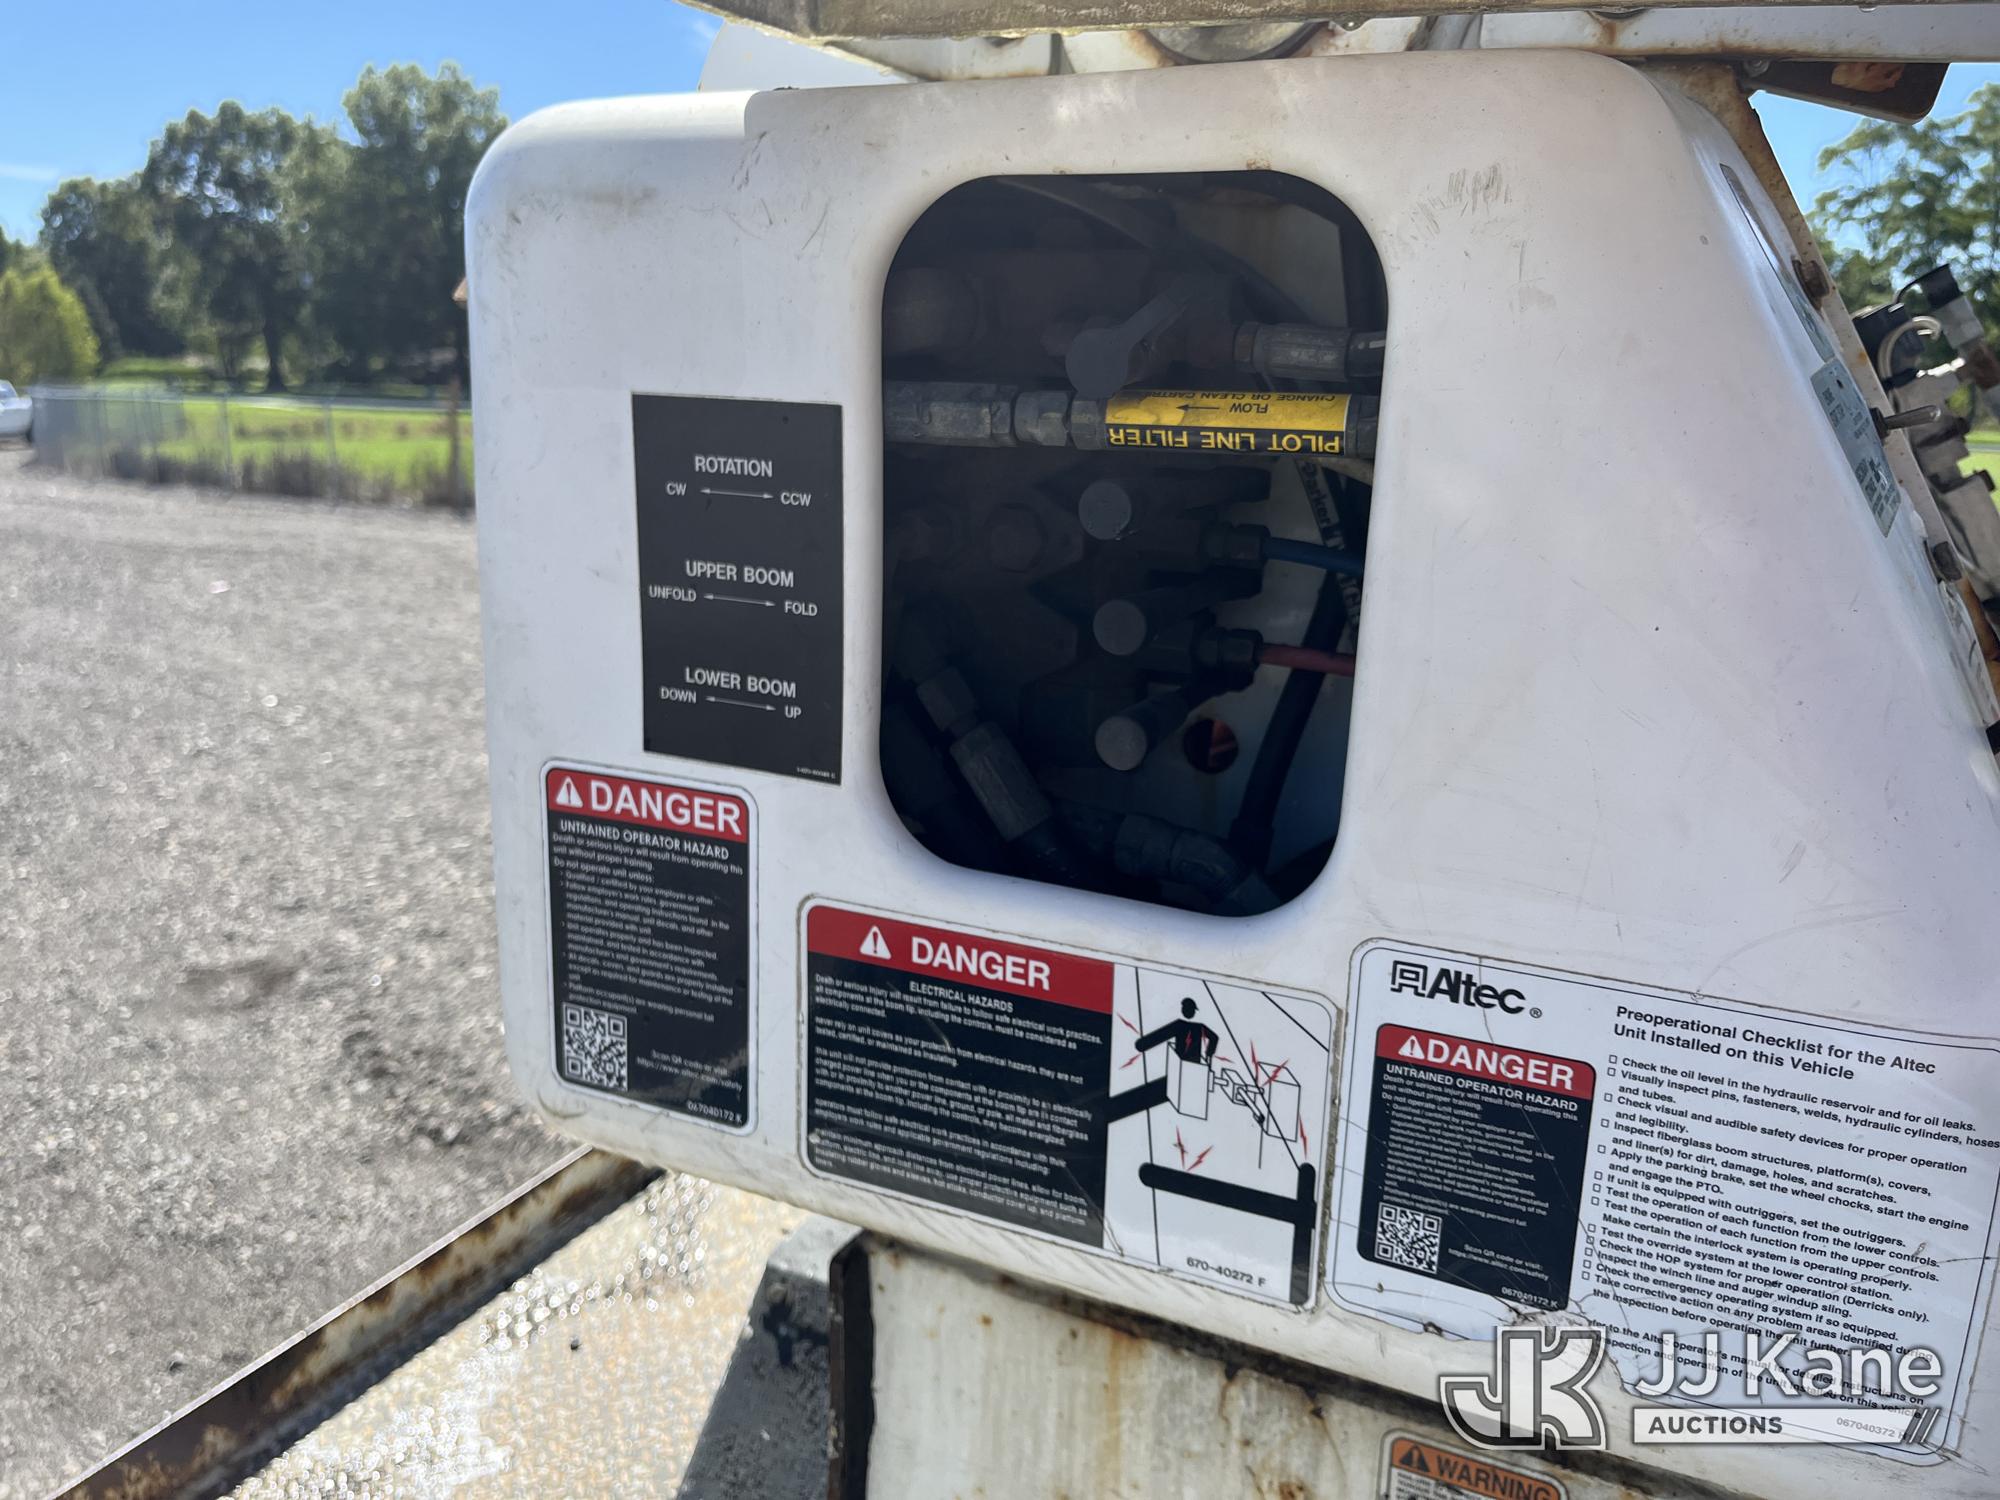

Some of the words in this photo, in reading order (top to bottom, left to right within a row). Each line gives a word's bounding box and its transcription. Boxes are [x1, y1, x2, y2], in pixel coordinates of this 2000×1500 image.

[1229, 403, 1268, 414] FLOW
[1108, 427, 1188, 448] FILTER
[1201, 430, 1254, 451] LINE
[1268, 432, 1340, 453] PILOT
[694, 456, 773, 478] ROTATION
[666, 482, 687, 496] CW
[780, 492, 812, 507] CCW
[685, 560, 737, 582] UPPER
[744, 566, 794, 588] BOOM
[648, 585, 697, 603] UNFOLD
[784, 601, 818, 617] FOLD
[660, 688, 697, 704] DOWN
[784, 704, 802, 720] UP
[685, 667, 741, 691] LOWER
[747, 676, 797, 699] BOOM
[590, 779, 741, 835] DANGER
[559, 819, 620, 840] UNTRAINED
[622, 829, 680, 850] OPERATOR
[683, 840, 729, 860] HAZARD
[911, 935, 1050, 990] DANGER
[909, 980, 966, 1002] ELECTRICAL
[967, 994, 1013, 1013] HAZARDS
[1427, 967, 1525, 1015] Altec
[1613, 1022, 1646, 1041] Unit
[1650, 1029, 1721, 1054] Installed
[1724, 1046, 1747, 1060] on
[1752, 1049, 1784, 1066] this
[1789, 1055, 1854, 1080] Vehicle
[1615, 1005, 1737, 1039] Preoperational
[1741, 1028, 1823, 1055] Checklist
[1827, 1044, 1853, 1060] for
[1856, 1049, 1886, 1066] the
[1889, 1055, 1936, 1074] Altec
[1426, 1038, 1574, 1090] DANGER
[1385, 1063, 1454, 1085] UNTRAINED
[1455, 1077, 1523, 1100] OPERATOR
[1525, 1092, 1578, 1111] HAZARD
[1617, 1085, 1640, 1096] and
[1641, 1088, 1676, 1104] tubes.
[1621, 1056, 1657, 1072] Check
[1659, 1064, 1678, 1076] the
[1679, 1069, 1695, 1079] oil
[1696, 1071, 1725, 1085] level
[1726, 1077, 1738, 1088] in
[1740, 1080, 1760, 1092] the
[1762, 1084, 1818, 1104] hydraulic
[1820, 1097, 1876, 1114] reservoir
[1877, 1108, 1901, 1119] and
[1903, 1111, 1922, 1123] for
[1923, 1116, 1940, 1126] oil
[1941, 1117, 1976, 1132] leaks.
[1614, 1110, 1636, 1122] and
[1638, 1113, 1689, 1134] legibility.
[1620, 1069, 1664, 1088] Visually
[1666, 1078, 1709, 1096] inspect
[1710, 1088, 1739, 1102] pins,
[1742, 1093, 1800, 1115] fasteners,
[1803, 1107, 1841, 1123] welds,
[1844, 1113, 1901, 1133] hydraulic
[1903, 1126, 1962, 1145] cylinders,
[1965, 1134, 2000, 1149] hoses
[1616, 1095, 1652, 1110] Check
[1654, 1104, 1688, 1118] visual
[1689, 1112, 1712, 1123] and
[1714, 1117, 1758, 1132] audible
[1759, 1126, 1796, 1142] safety
[1797, 1133, 1844, 1150] devices
[1847, 1142, 1865, 1154] for
[1866, 1148, 1908, 1162] proper
[1909, 1156, 1967, 1174] operation
[1608, 1162, 1629, 1173] and
[1631, 1167, 1673, 1183] engage
[1674, 1176, 1693, 1188] the
[1695, 1180, 1724, 1195] PTO.
[1611, 1136, 1633, 1147] and
[1634, 1139, 1674, 1158] liner(s)
[1676, 1148, 1693, 1160] for
[1694, 1153, 1718, 1167] dirt,
[1720, 1159, 1769, 1178] damage,
[1772, 1169, 1807, 1186] holes,
[1810, 1179, 1833, 1190] and
[1835, 1184, 1897, 1204] scratches.
[1613, 1120, 1654, 1138] Inspect
[1656, 1130, 1712, 1150] fiberglass
[1714, 1142, 1748, 1158] boom
[1750, 1152, 1813, 1172] structures,
[1815, 1165, 1884, 1187] platform(s),
[1887, 1180, 1931, 1197] covers,
[1606, 1173, 1615, 1183] If
[1616, 1177, 1638, 1189] unit
[1640, 1180, 1651, 1191] is
[1652, 1185, 1706, 1204] equipped
[1707, 1197, 1732, 1209] with
[1734, 1204, 1797, 1225] outriggers,
[1799, 1218, 1818, 1229] set
[1820, 1221, 1840, 1233] the
[1841, 1227, 1906, 1247] outriggers.
[1610, 1147, 1642, 1163] Apply
[1644, 1154, 1663, 1166] the
[1664, 1160, 1708, 1178] parking
[1710, 1168, 1745, 1186] brake,
[1748, 1179, 1767, 1189] set
[1769, 1182, 1788, 1194] the
[1790, 1187, 1825, 1202] wheel
[1827, 1195, 1873, 1213] chocks,
[1875, 1206, 1904, 1218] start
[1906, 1210, 1926, 1223] the
[1927, 1216, 1969, 1231] engine
[1186, 1256, 1254, 1285] 670-40272
[1257, 1276, 1267, 1287] F
[1598, 1238, 1633, 1254] Check
[1635, 1247, 1653, 1259] the
[1655, 1251, 1681, 1264] HOP
[1682, 1260, 1724, 1275] system
[1725, 1268, 1743, 1279] for
[1784, 1283, 1840, 1302] operation
[1842, 1294, 1895, 1314] (Derricks
[1896, 1308, 1929, 1323] only).
[1437, 1455, 1551, 1500] WARNING
